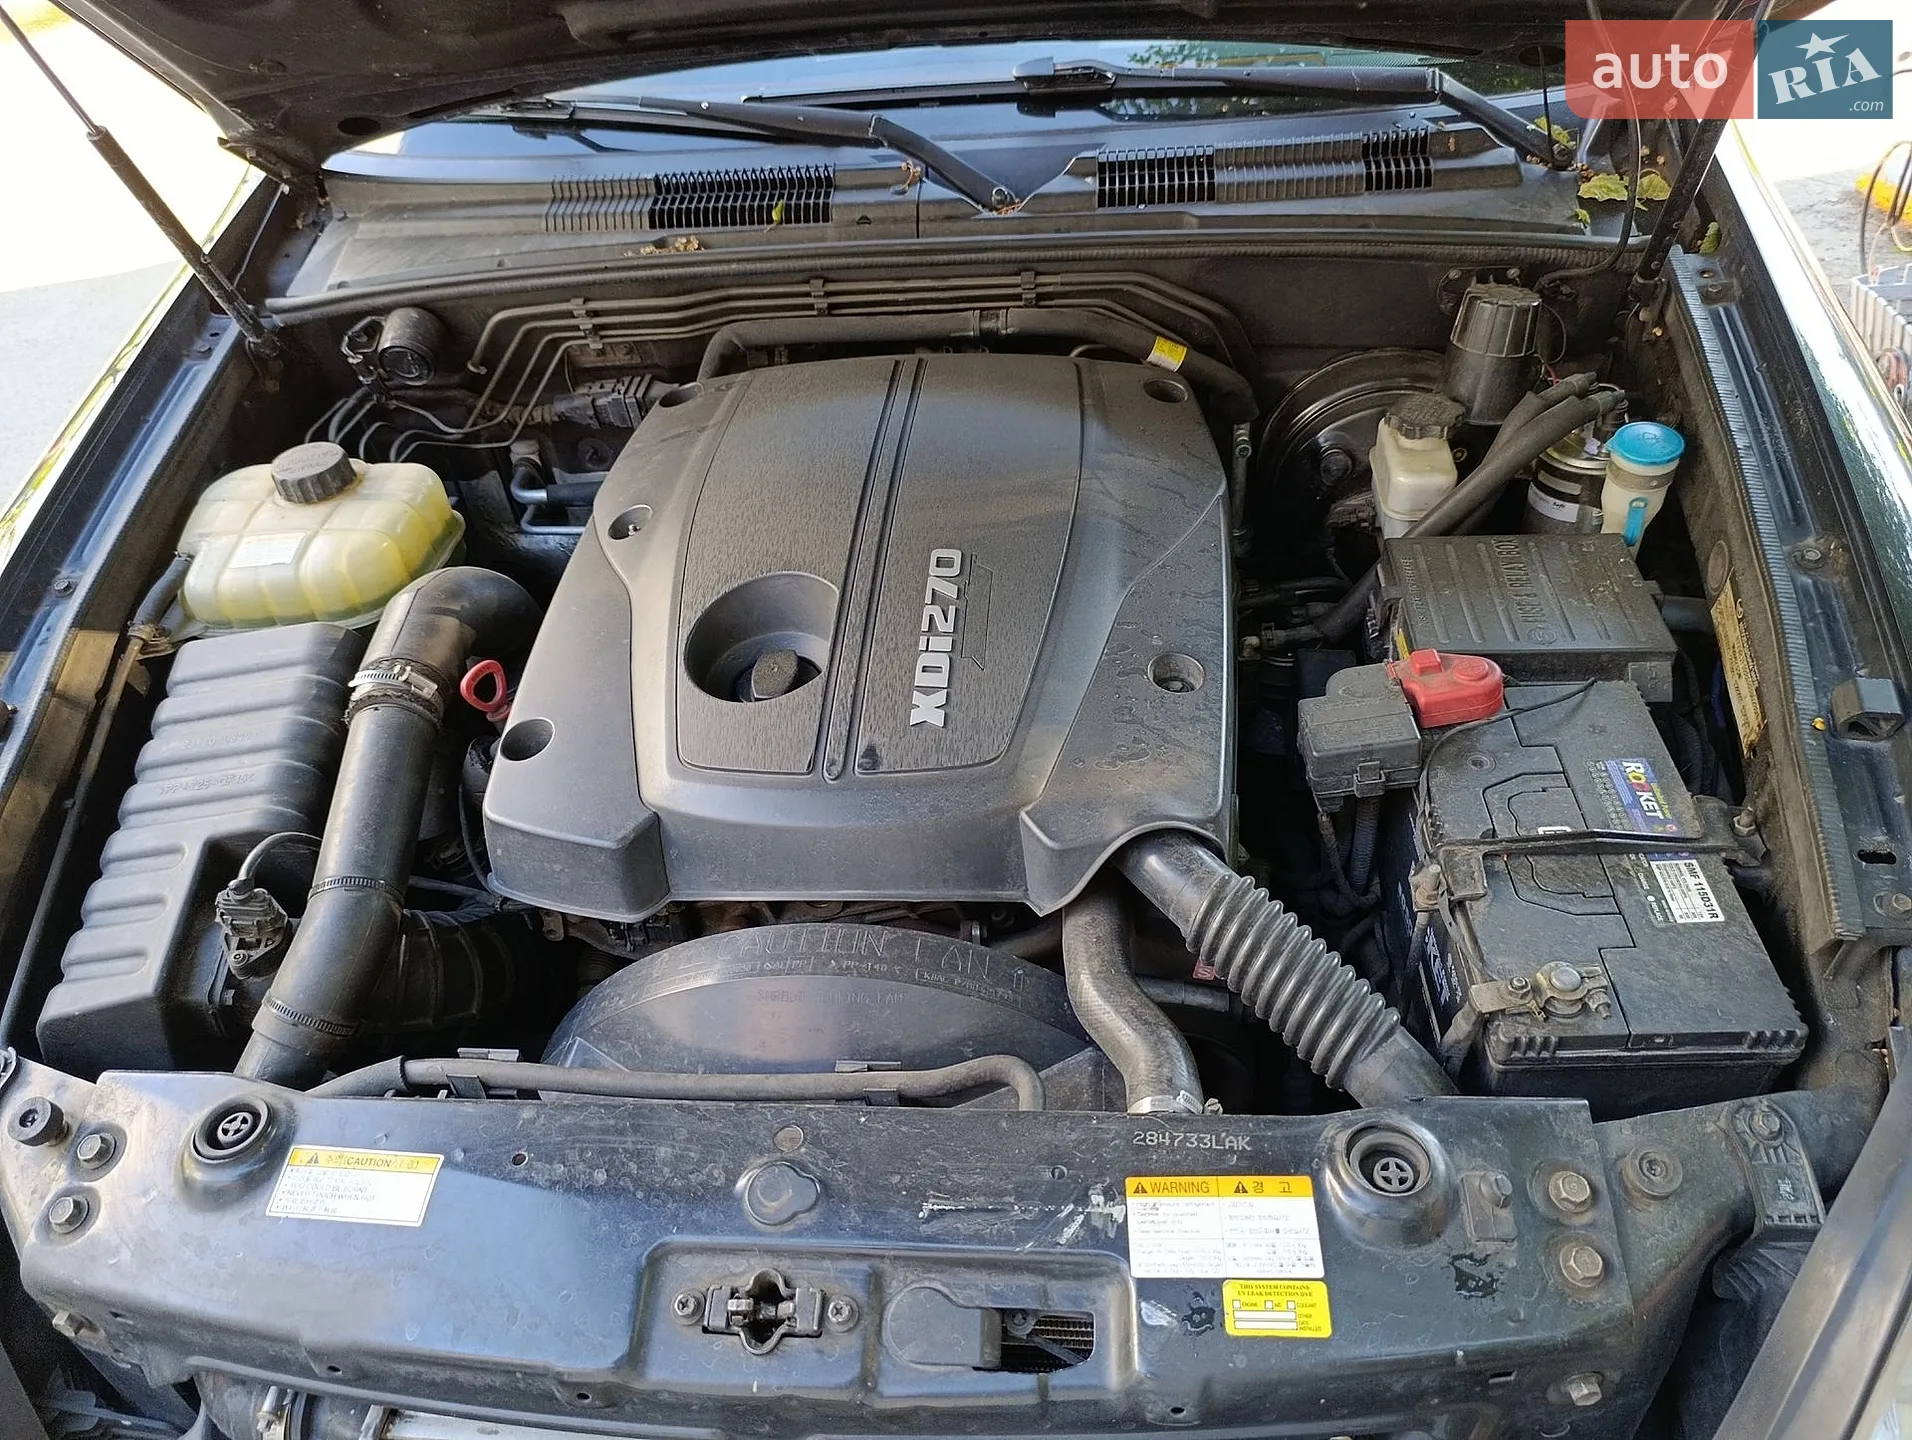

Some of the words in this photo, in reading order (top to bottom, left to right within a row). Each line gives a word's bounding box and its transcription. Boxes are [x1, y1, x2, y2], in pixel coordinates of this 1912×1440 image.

[910, 549, 962, 727] XDi270
[1684, 862, 1700, 880] SMF
[1694, 881, 1719, 919] 115D31R
[1149, 1181, 1210, 1194] WARNING
[1279, 1182, 1293, 1194] 고
